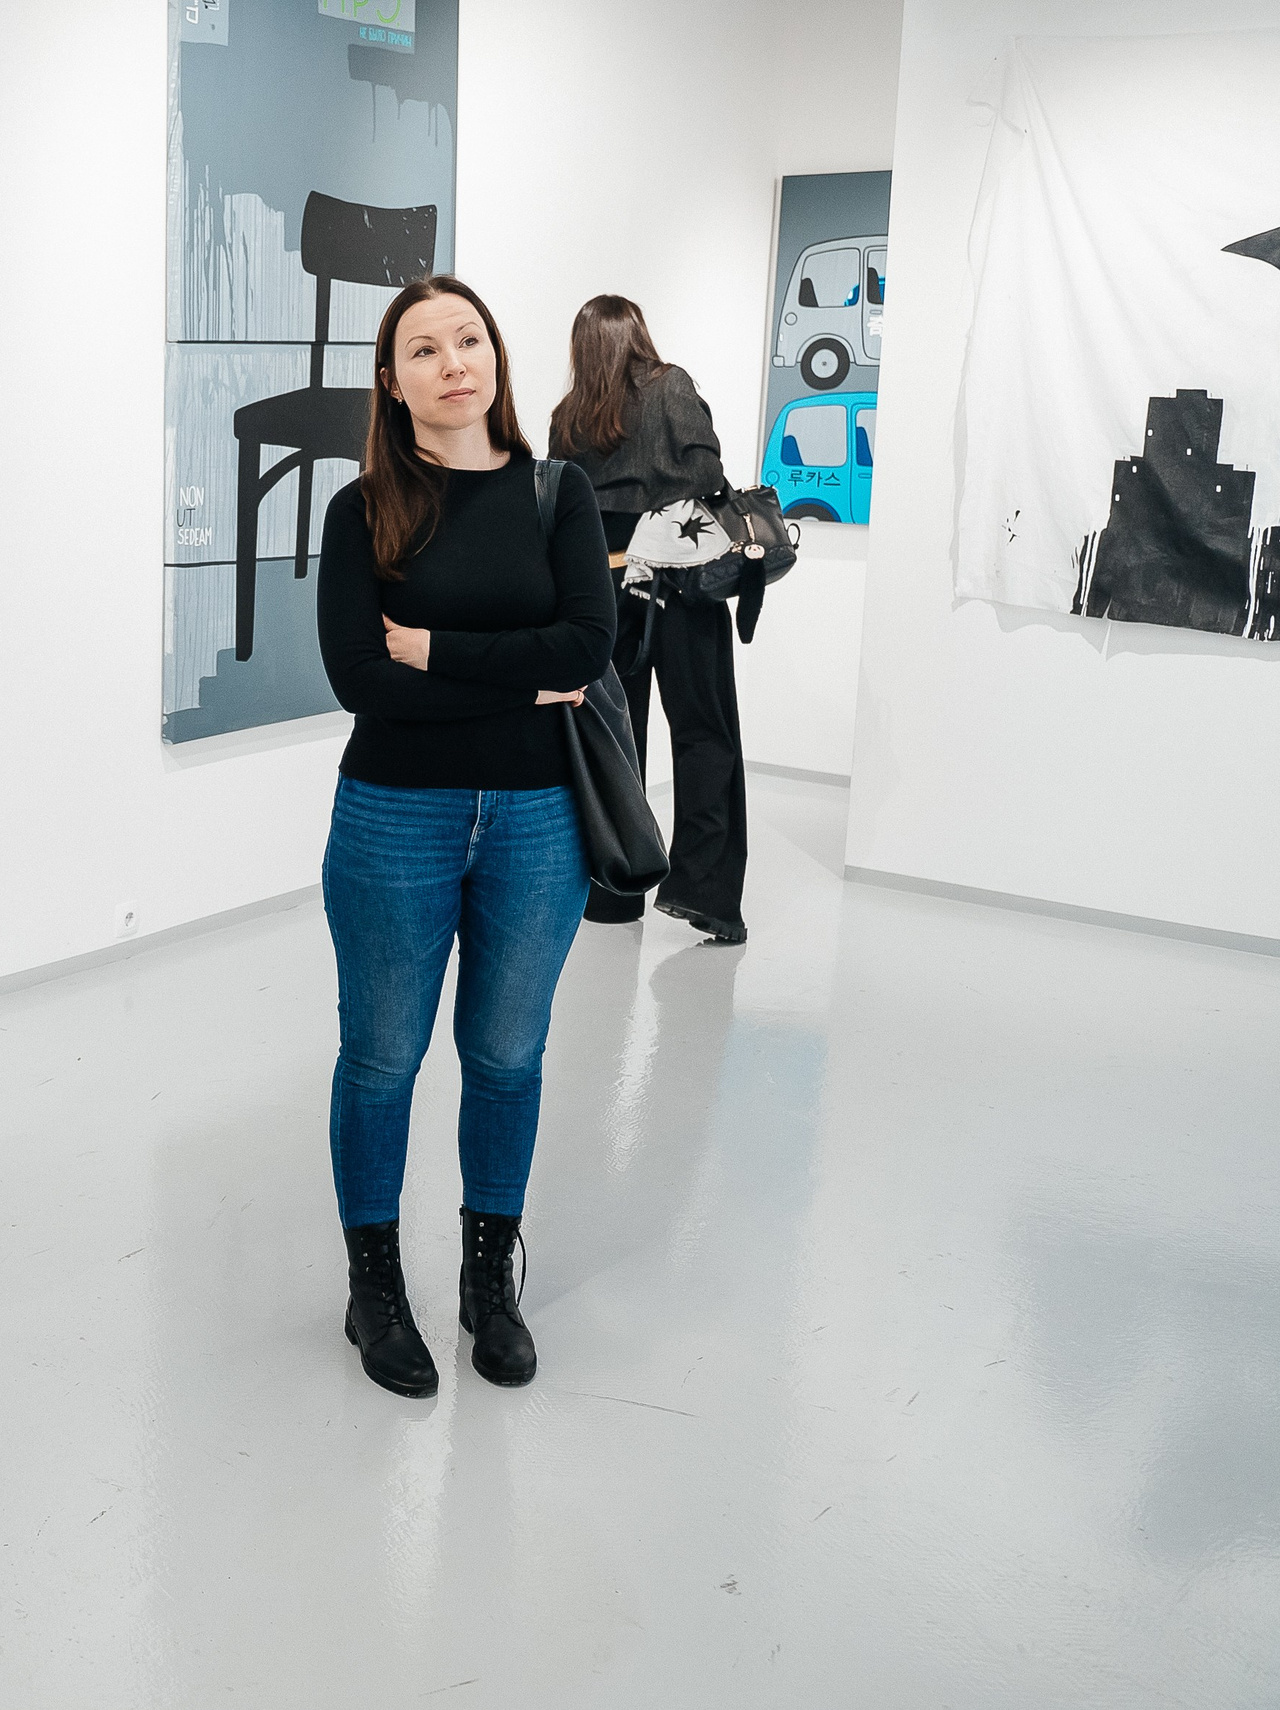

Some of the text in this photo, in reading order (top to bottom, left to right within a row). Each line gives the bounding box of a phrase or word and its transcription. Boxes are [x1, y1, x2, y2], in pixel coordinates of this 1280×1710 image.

[787, 469, 841, 488] 루카스
[179, 485, 205, 508] NON
[176, 507, 196, 528] UT
[177, 526, 213, 547] SEDEAM
